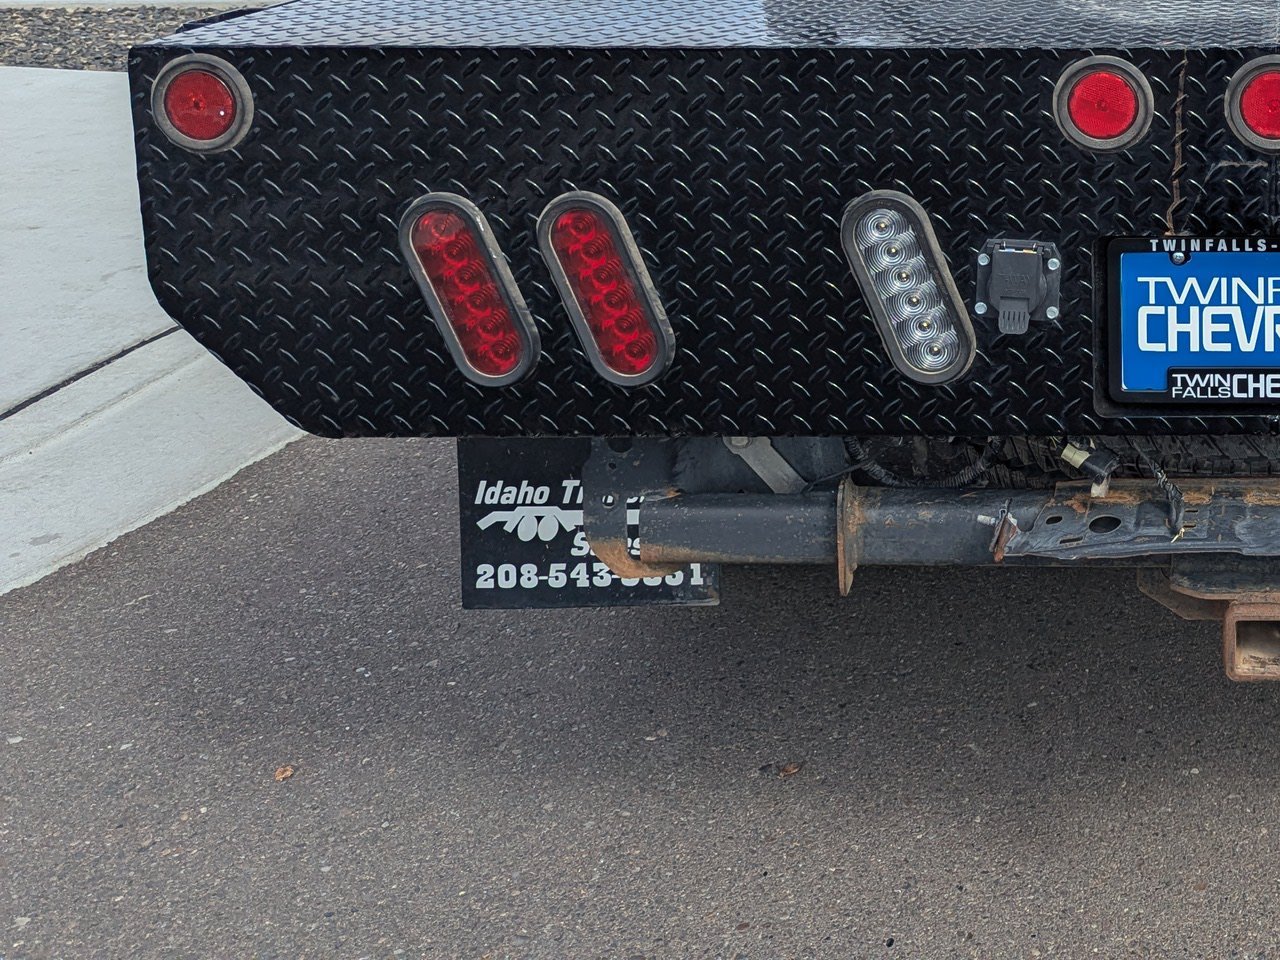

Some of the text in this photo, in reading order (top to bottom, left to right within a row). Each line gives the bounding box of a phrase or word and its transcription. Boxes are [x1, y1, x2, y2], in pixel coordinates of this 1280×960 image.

[1172, 373, 1231, 386] TWIN
[1172, 386, 1231, 399] FALLS
[474, 480, 550, 505] Idaho
